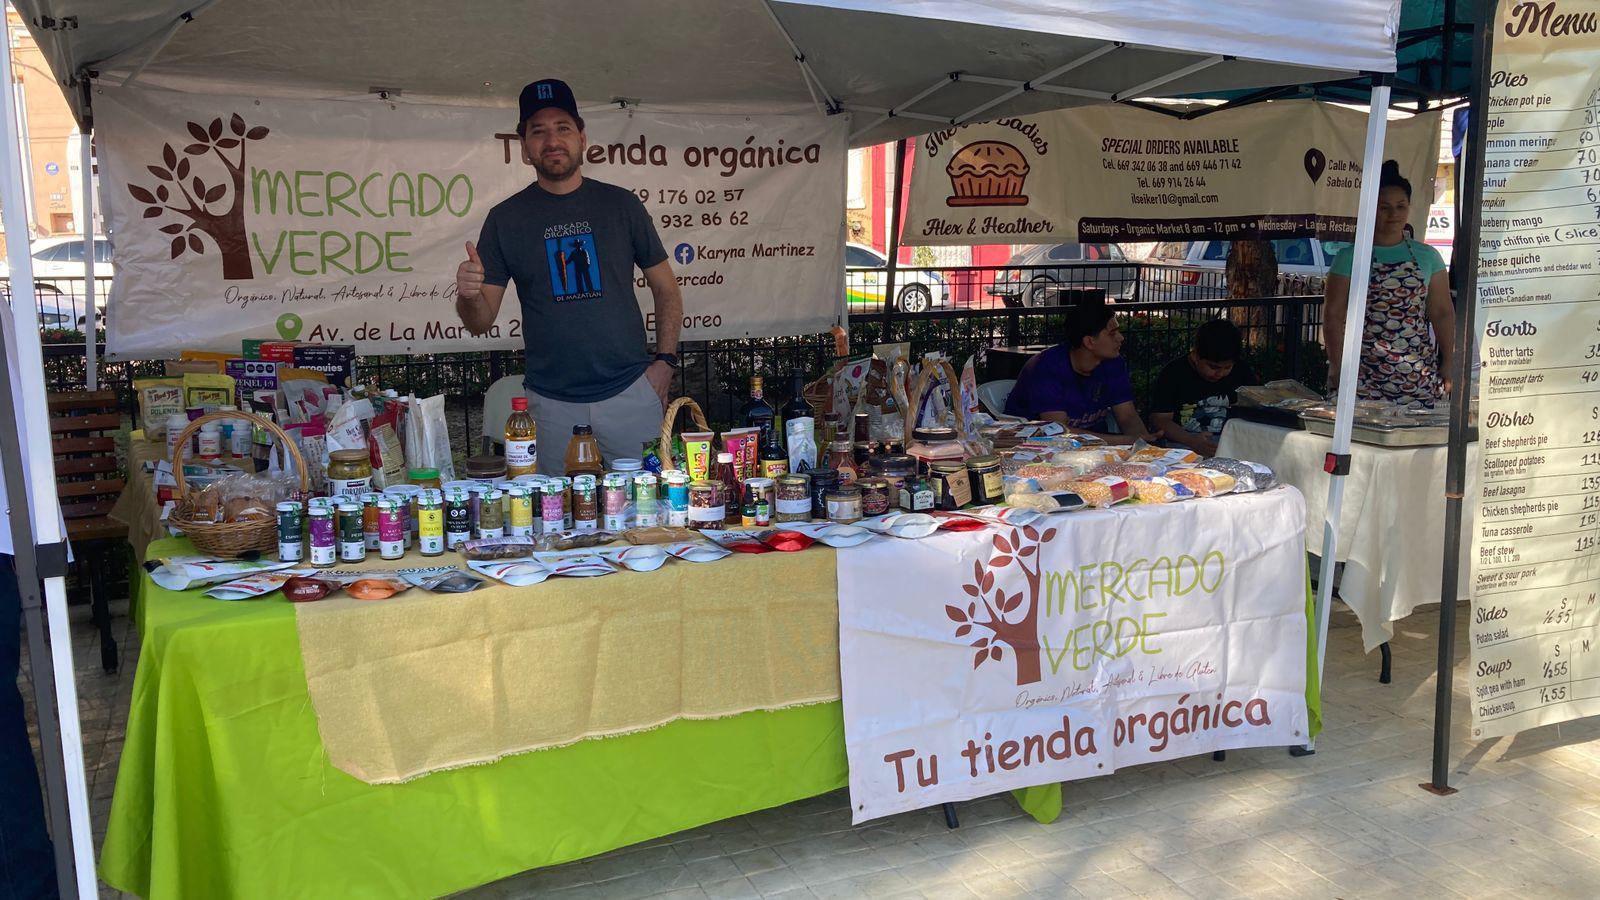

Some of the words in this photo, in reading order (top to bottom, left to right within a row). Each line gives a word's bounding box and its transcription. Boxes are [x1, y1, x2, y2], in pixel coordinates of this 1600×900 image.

[1505, 2, 1597, 37] Menu
[1490, 71, 1528, 88] Pies
[1520, 94, 1534, 106] pot
[1536, 94, 1551, 107] pie
[1102, 138, 1142, 154] SPECIAL
[1146, 140, 1180, 154] ORDERS
[1184, 139, 1239, 154] AVAILABLE
[1580, 132, 1593, 144] 60
[579, 135, 667, 166] enda
[683, 136, 820, 177] orgánica
[1578, 149, 1596, 164] 70
[1118, 160, 1129, 170] 669
[1132, 161, 1144, 172] 342
[1147, 161, 1156, 172] 06
[1158, 161, 1168, 172] 38
[1170, 161, 1184, 172] and
[1186, 160, 1200, 170] 669
[1203, 160, 1218, 170] 446
[1220, 159, 1230, 170] 71
[1232, 159, 1242, 169] 42
[1328, 160, 1346, 170] Calle
[1152, 178, 1164, 188] 669
[1168, 178, 1182, 188] 914
[1184, 177, 1194, 188] 26
[1196, 176, 1206, 187] 44
[1483, 178, 1506, 187] alnut
[251, 166, 474, 218] MERCADO
[658, 190, 688, 204] 176
[695, 190, 716, 204] 02
[724, 189, 745, 202] 57
[545, 221, 589, 233] MERCADO
[661, 214, 694, 229] 932
[701, 212, 722, 226] 86
[730, 211, 749, 226] 62
[922, 218, 963, 236] Alex
[966, 218, 976, 234] &
[982, 216, 1053, 235] Heather
[1082, 222, 1119, 236] Saturdays
[1126, 224, 1155, 236] Organic
[1157, 224, 1184, 234] Market
[1185, 224, 1190, 234] 8
[1192, 225, 1206, 234] am
[1214, 222, 1224, 233] 12
[1225, 223, 1238, 235] pm
[1258, 220, 1296, 232] Wednesday
[1480, 218, 1510, 230] lueberry
[1512, 216, 1542, 227] mango
[1480, 238, 1501, 250] ango
[1504, 236, 1534, 246] chiffon
[1536, 233, 1550, 244] pie
[252, 230, 414, 276] VERDE
[697, 246, 746, 263] Karyna
[751, 243, 815, 258] Martinez
[1478, 257, 1508, 268] Cheese
[1510, 254, 1540, 268] quiche
[676, 271, 724, 286] ercado
[331, 285, 383, 302] Artesanal
[398, 282, 428, 302] Libre
[429, 285, 440, 298] de
[1478, 286, 1514, 298] Totillers
[682, 312, 722, 329] oreo
[1486, 320, 1537, 337] Tarts
[308, 324, 344, 342] Av.
[354, 322, 380, 340] de
[390, 322, 415, 340] La
[424, 321, 500, 340] Mara
[1489, 348, 1513, 358] Butter
[1516, 347, 1534, 357] tarts
[1489, 376, 1527, 386] Mincemeat
[1528, 374, 1544, 383] tarts
[1582, 371, 1598, 382] 40
[1486, 411, 1534, 428] Dishes
[1592, 406, 1598, 420] S
[1486, 438, 1501, 450] Beef
[1502, 434, 1536, 450] shepherds
[1538, 434, 1548, 446] pie
[1484, 458, 1517, 470] Scalloped
[1519, 456, 1546, 468] potatoes
[1483, 486, 1500, 498] Beef
[1500, 485, 1526, 497] lasagna
[1482, 506, 1508, 518] Chicken
[1510, 502, 1546, 516] shepherds
[1548, 500, 1558, 513] pie
[1482, 527, 1498, 538] Tuna
[1500, 524, 1533, 536] casserole
[1480, 546, 1496, 557] Beef
[1498, 546, 1514, 556] stew
[1046, 550, 1225, 618] MERCADO
[1477, 574, 1496, 584] Sweet
[1505, 571, 1520, 580] sour
[1521, 568, 1536, 580] pork
[1476, 606, 1508, 624] Sides
[1042, 612, 1167, 675] VERDE
[1476, 632, 1493, 644] Potato
[1494, 628, 1509, 639] salad
[1476, 659, 1512, 678] Soups
[1554, 644, 1560, 657] S
[1583, 640, 1590, 652] M
[1480, 702, 1502, 717] Chicken
[1503, 700, 1516, 712] soup
[883, 748, 939, 793] Tu
[961, 715, 1098, 778] tienda
[1113, 692, 1272, 752] orgánica
